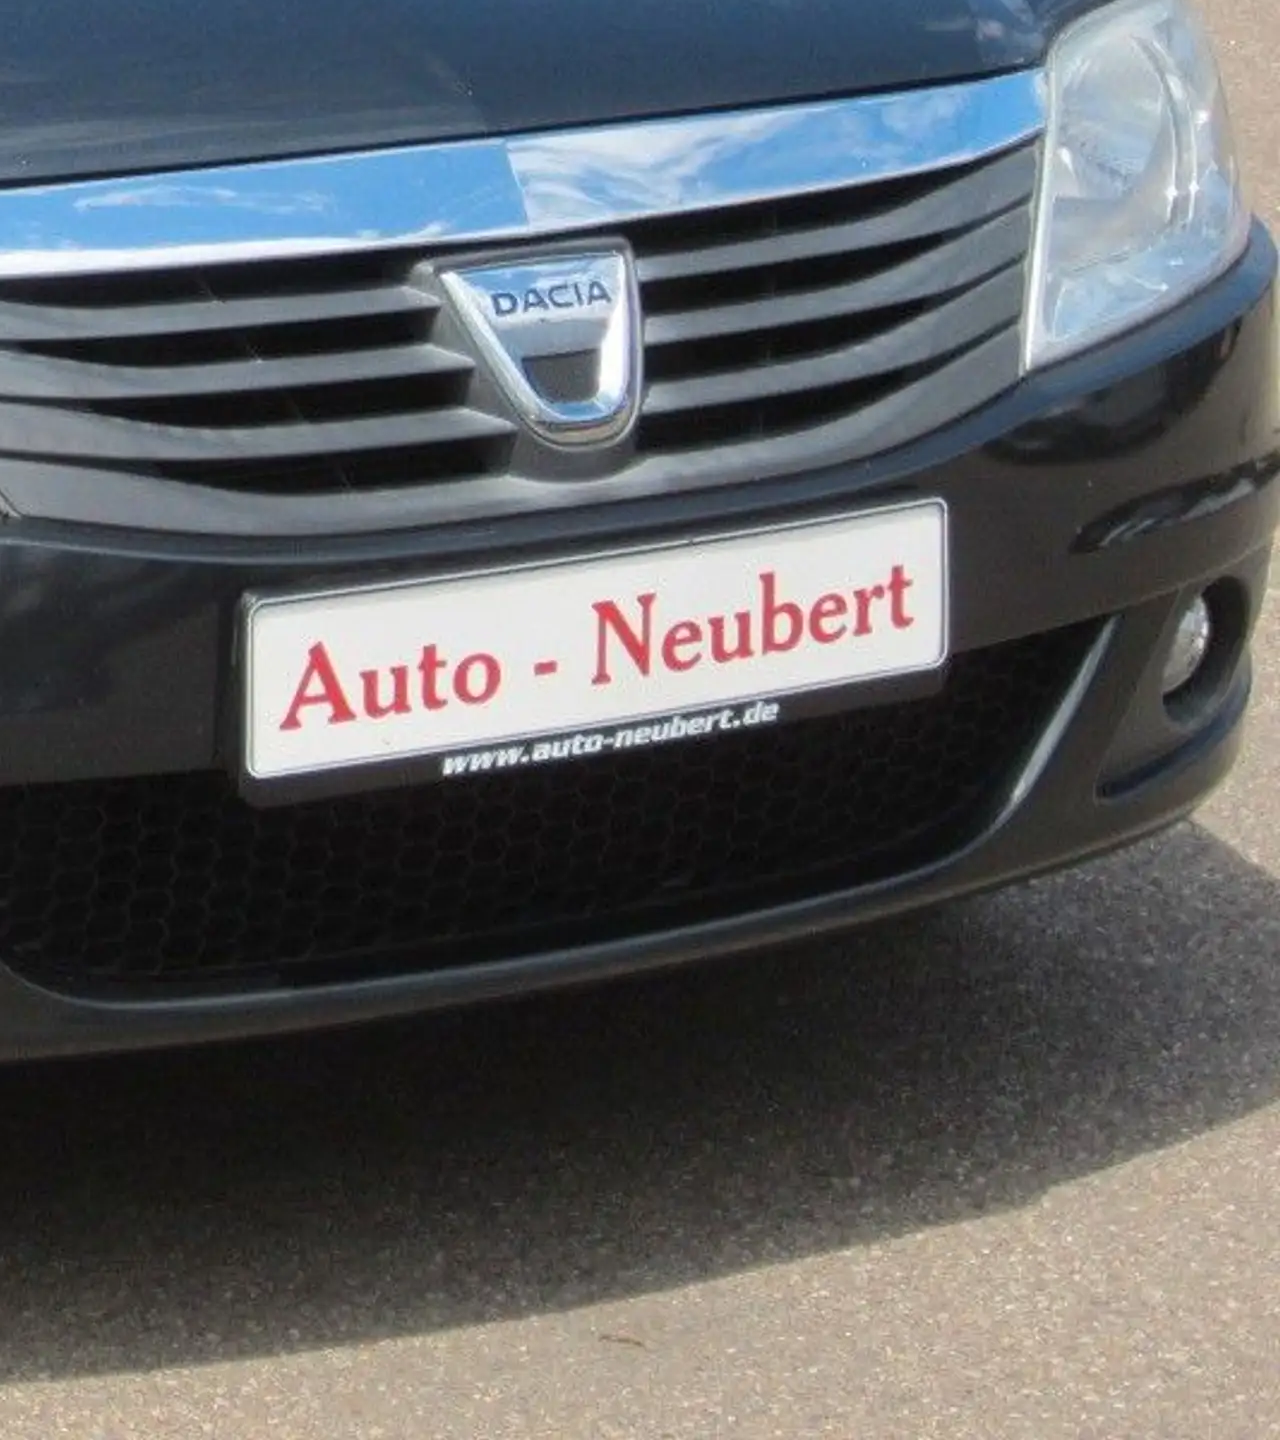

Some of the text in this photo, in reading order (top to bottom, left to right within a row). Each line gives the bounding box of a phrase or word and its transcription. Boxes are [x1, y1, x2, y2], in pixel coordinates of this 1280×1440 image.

[493, 280, 612, 317] DACIA
[279, 564, 915, 731] Auto - Neubert
[441, 700, 781, 777] www.auto-neubert.de
